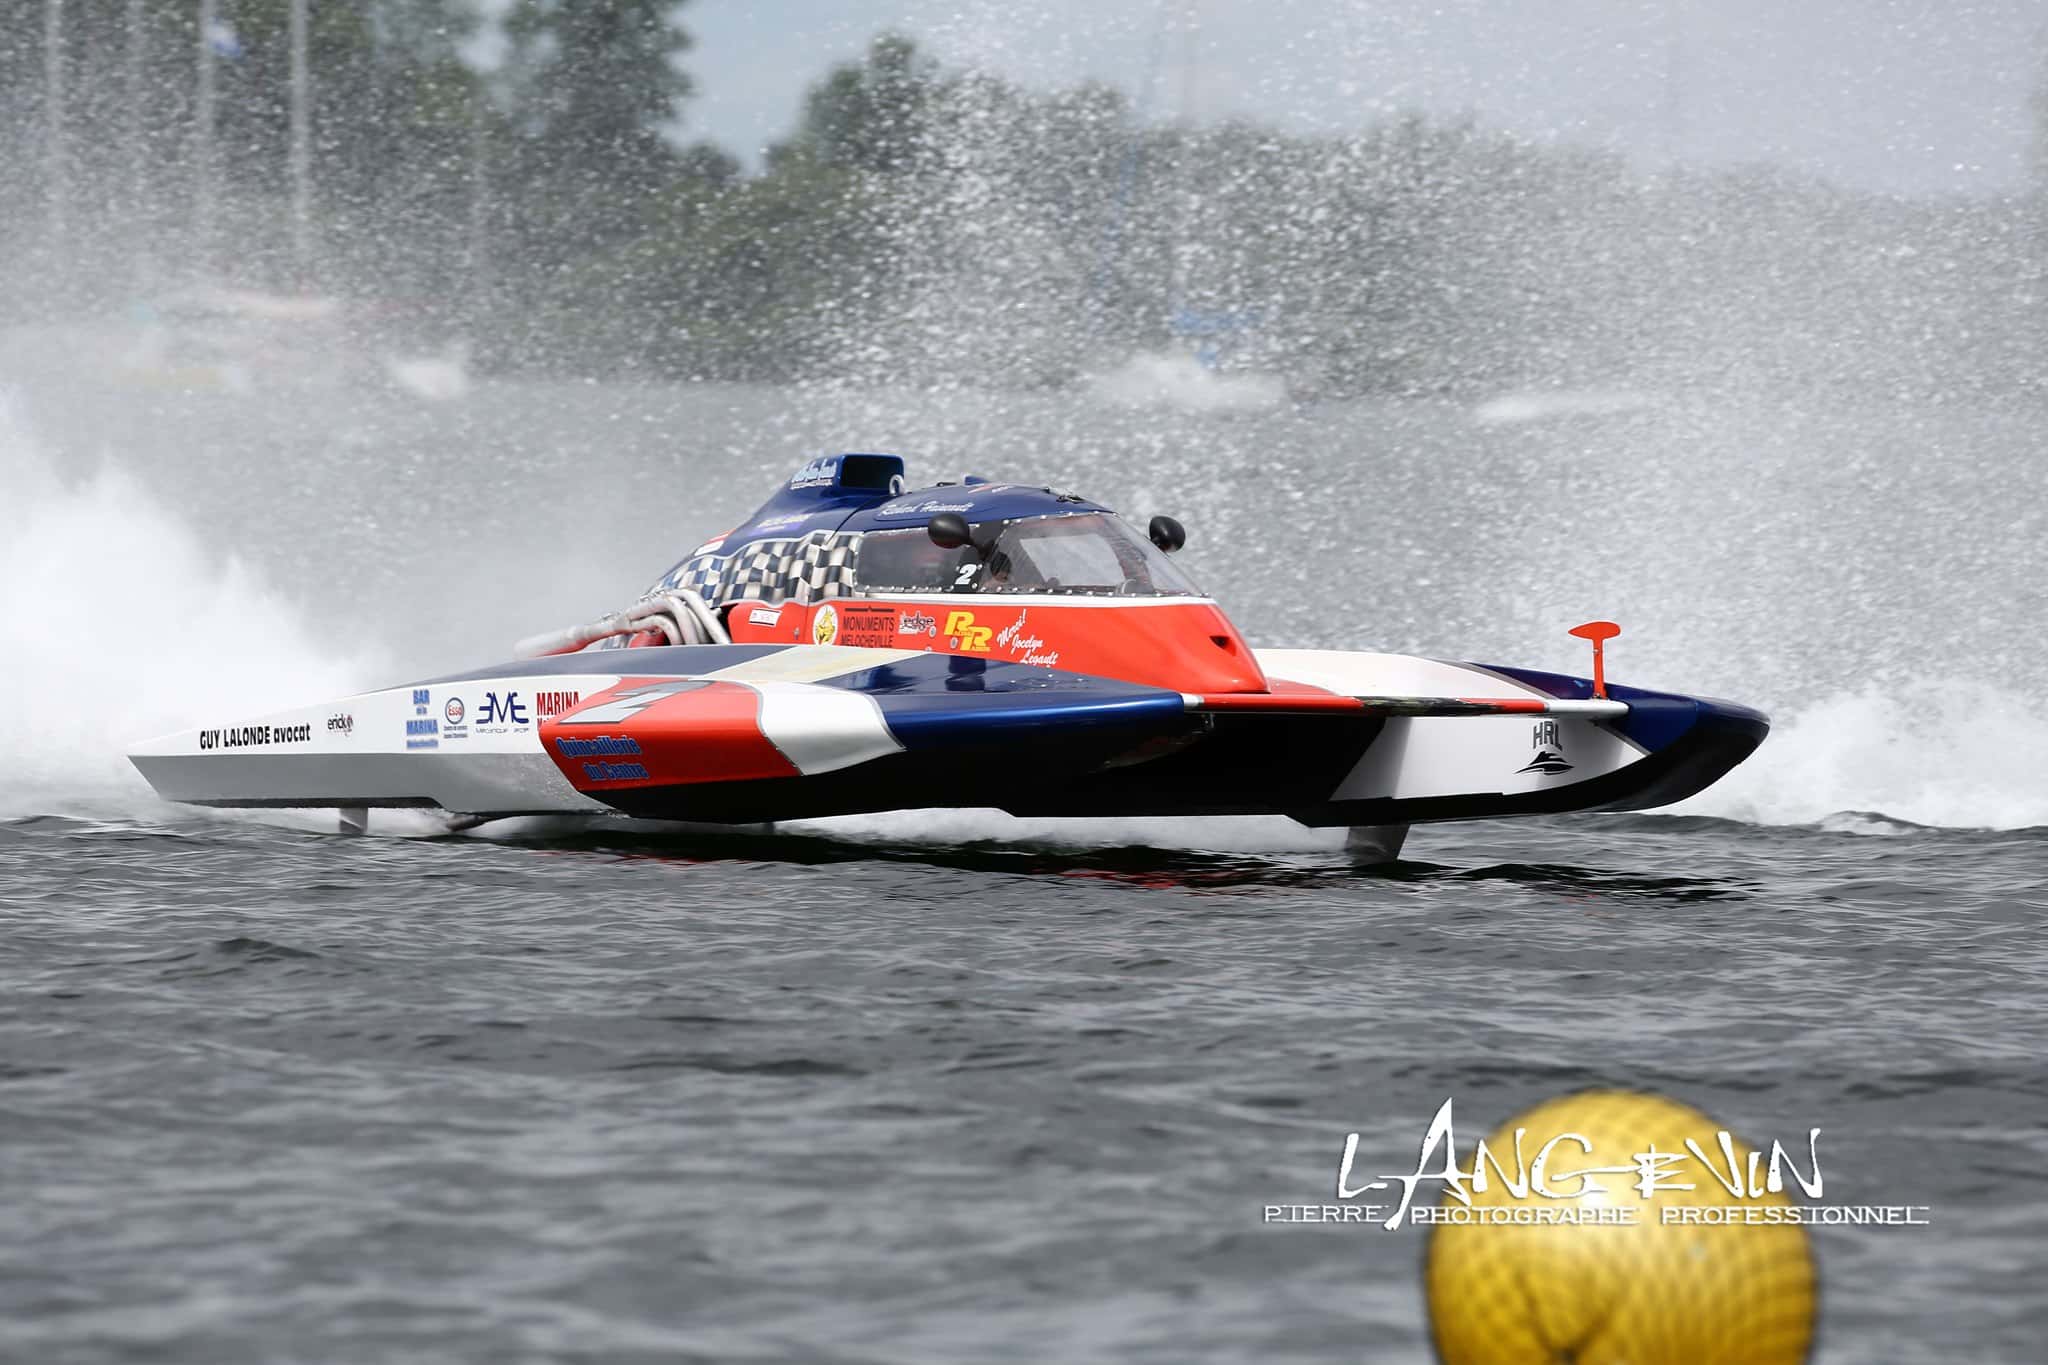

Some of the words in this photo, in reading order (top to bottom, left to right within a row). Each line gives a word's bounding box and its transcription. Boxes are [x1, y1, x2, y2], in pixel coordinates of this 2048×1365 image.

[955, 564, 977, 584] 2
[843, 616, 895, 632] MONUMENTS
[1020, 651, 1059, 666] Legault
[200, 729, 220, 749] GUY
[223, 726, 270, 747] LALONDE
[274, 722, 311, 743] avocat
[406, 720, 438, 736] MARINA
[1533, 720, 1562, 751] HRL
